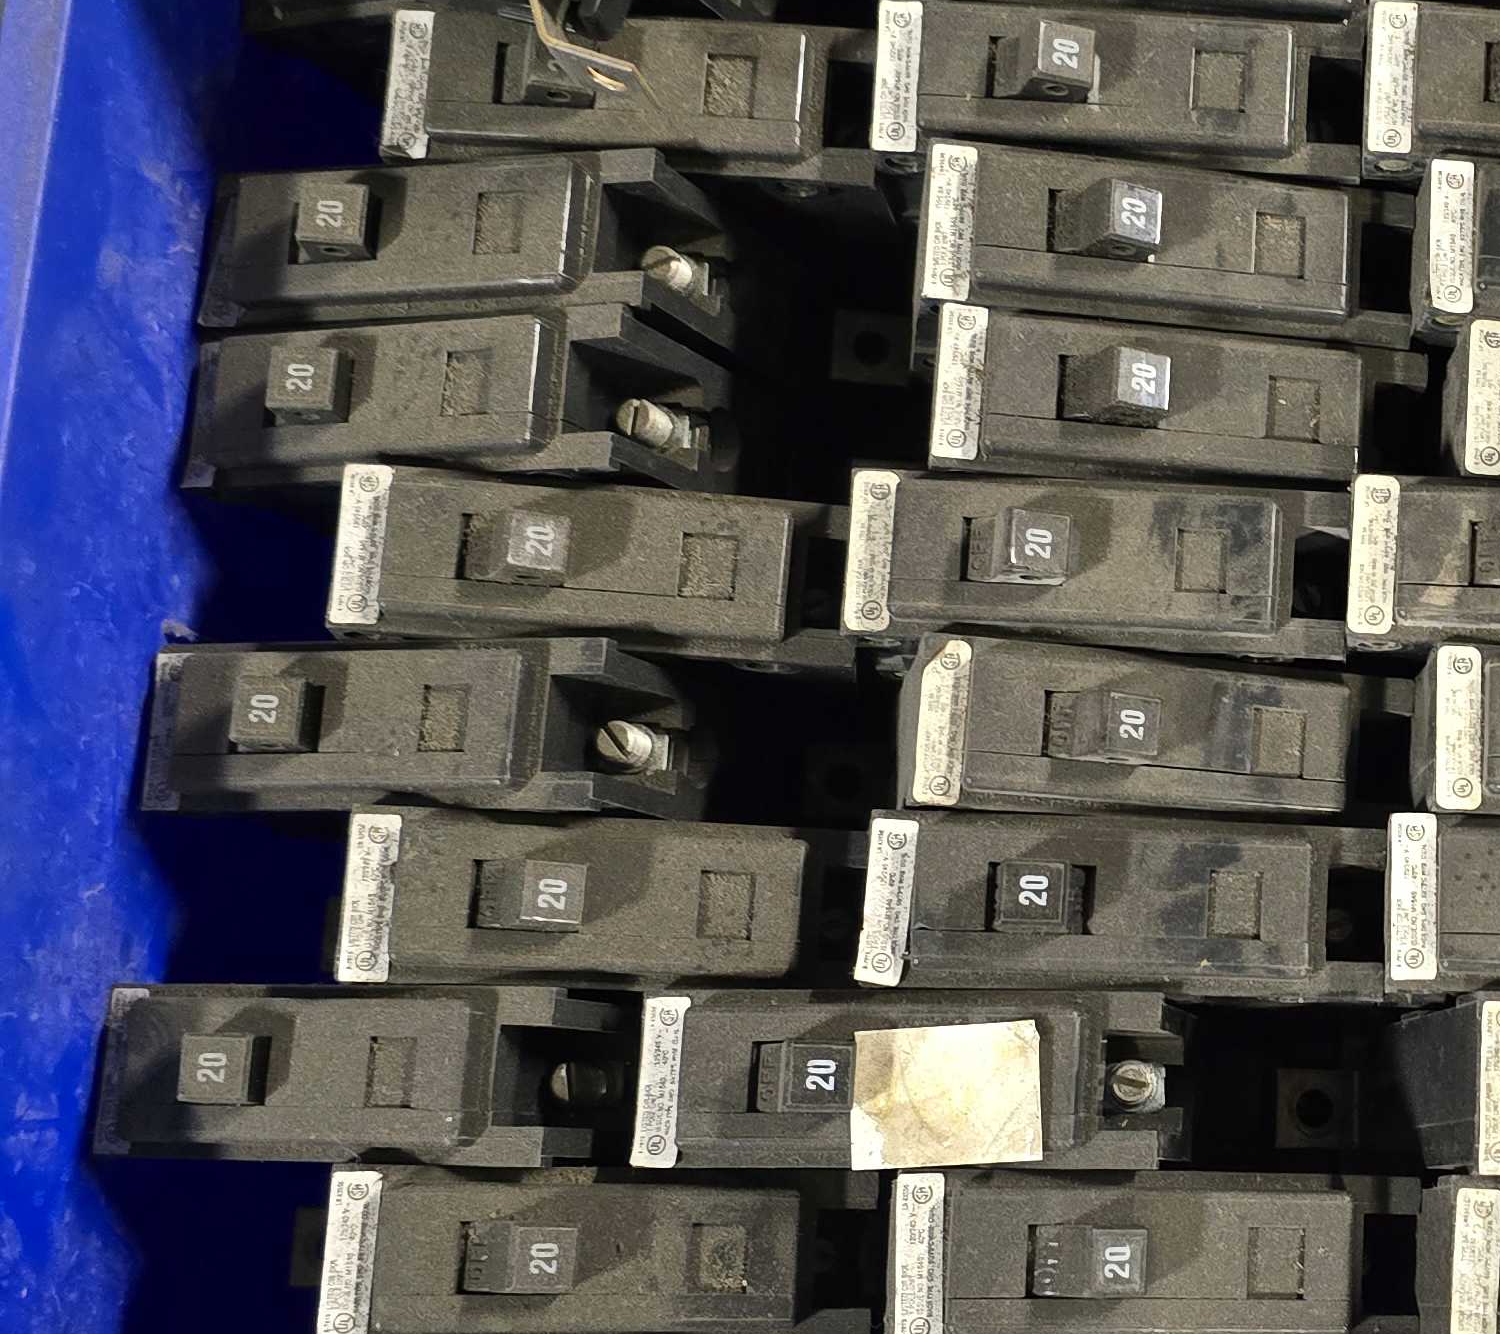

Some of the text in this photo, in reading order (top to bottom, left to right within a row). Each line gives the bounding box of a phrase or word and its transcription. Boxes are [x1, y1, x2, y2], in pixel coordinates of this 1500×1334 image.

[1054, 37, 1079, 70] 20
[316, 200, 344, 228] 20
[1122, 198, 1147, 228] 20
[287, 364, 314, 392] 20
[1131, 361, 1156, 393] 20
[527, 525, 555, 556] 20
[1025, 528, 1052, 558] 20
[249, 694, 279, 723] 20
[1120, 709, 1145, 740] 20
[538, 878, 568, 910] 20
[1019, 875, 1048, 906] 20
[197, 1052, 227, 1083] 20
[806, 1059, 837, 1091] 20
[529, 1242, 559, 1274] 20
[1104, 1245, 1130, 1279] 20
